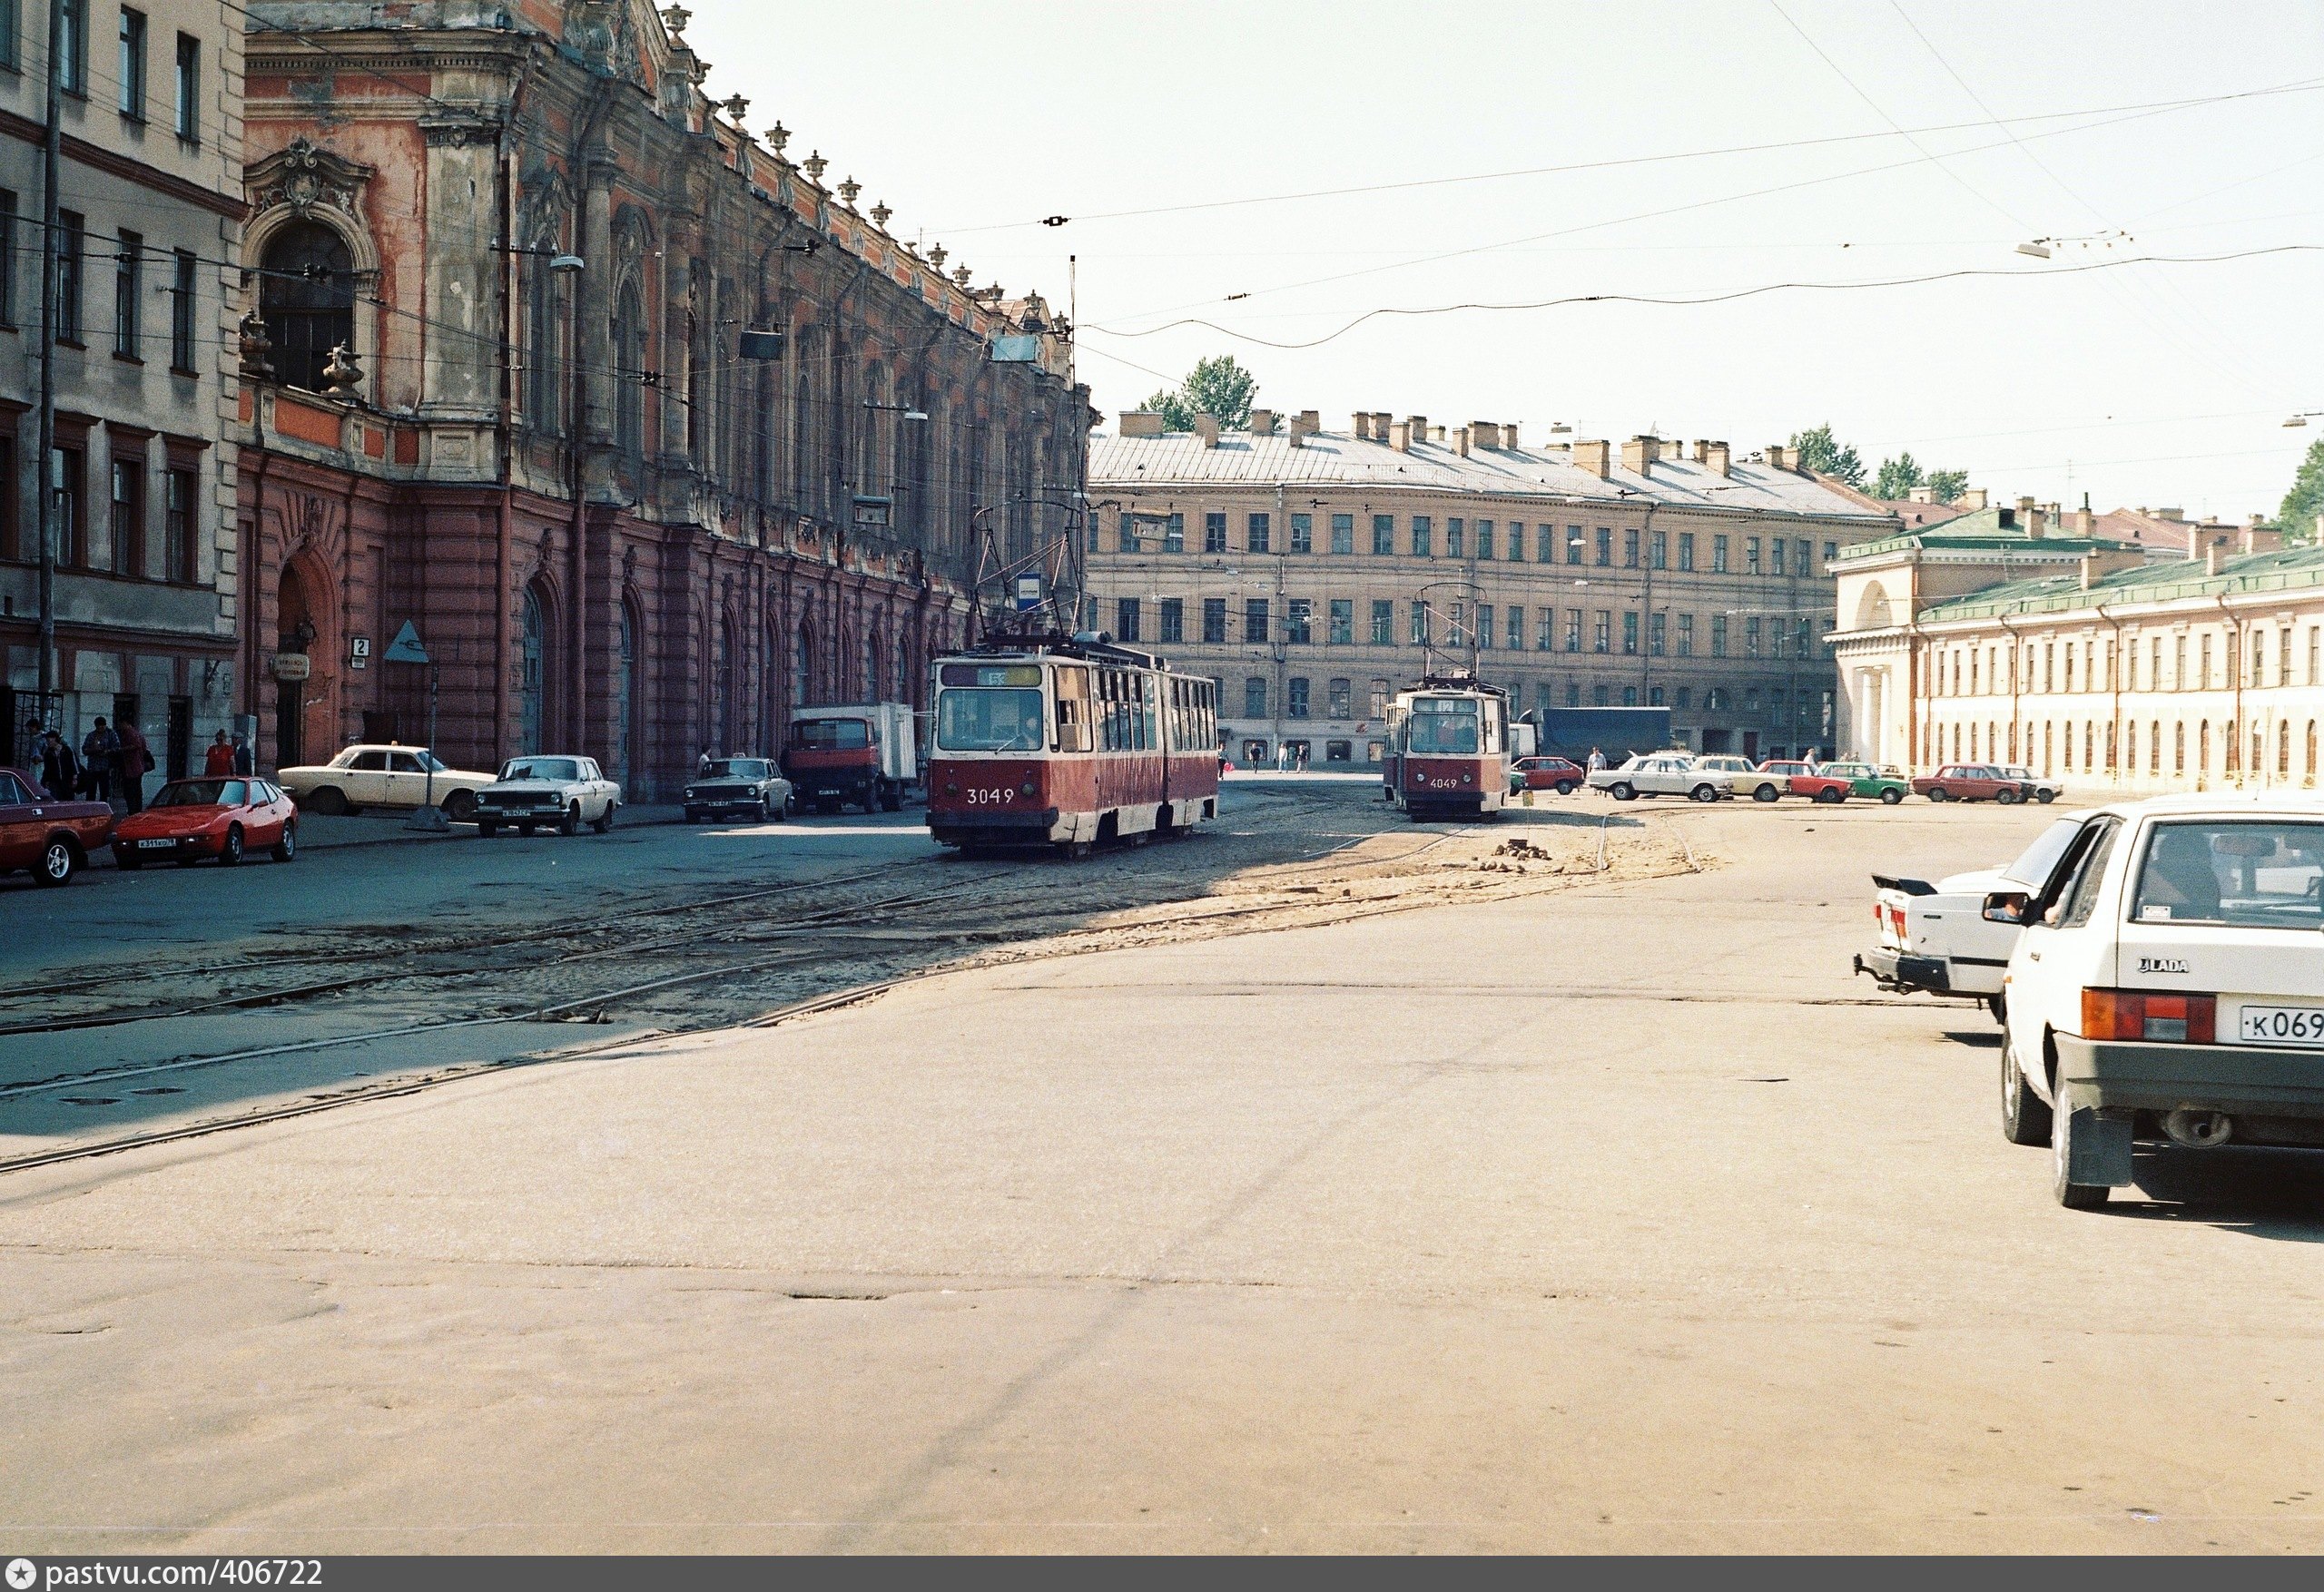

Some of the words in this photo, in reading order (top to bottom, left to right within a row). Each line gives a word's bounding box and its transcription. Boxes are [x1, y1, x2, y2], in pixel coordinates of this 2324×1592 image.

[358, 640, 365, 654] 2
[1430, 779, 1457, 788] 4049
[967, 788, 1014, 803] 3049
[2150, 958, 2189, 973] LADA
